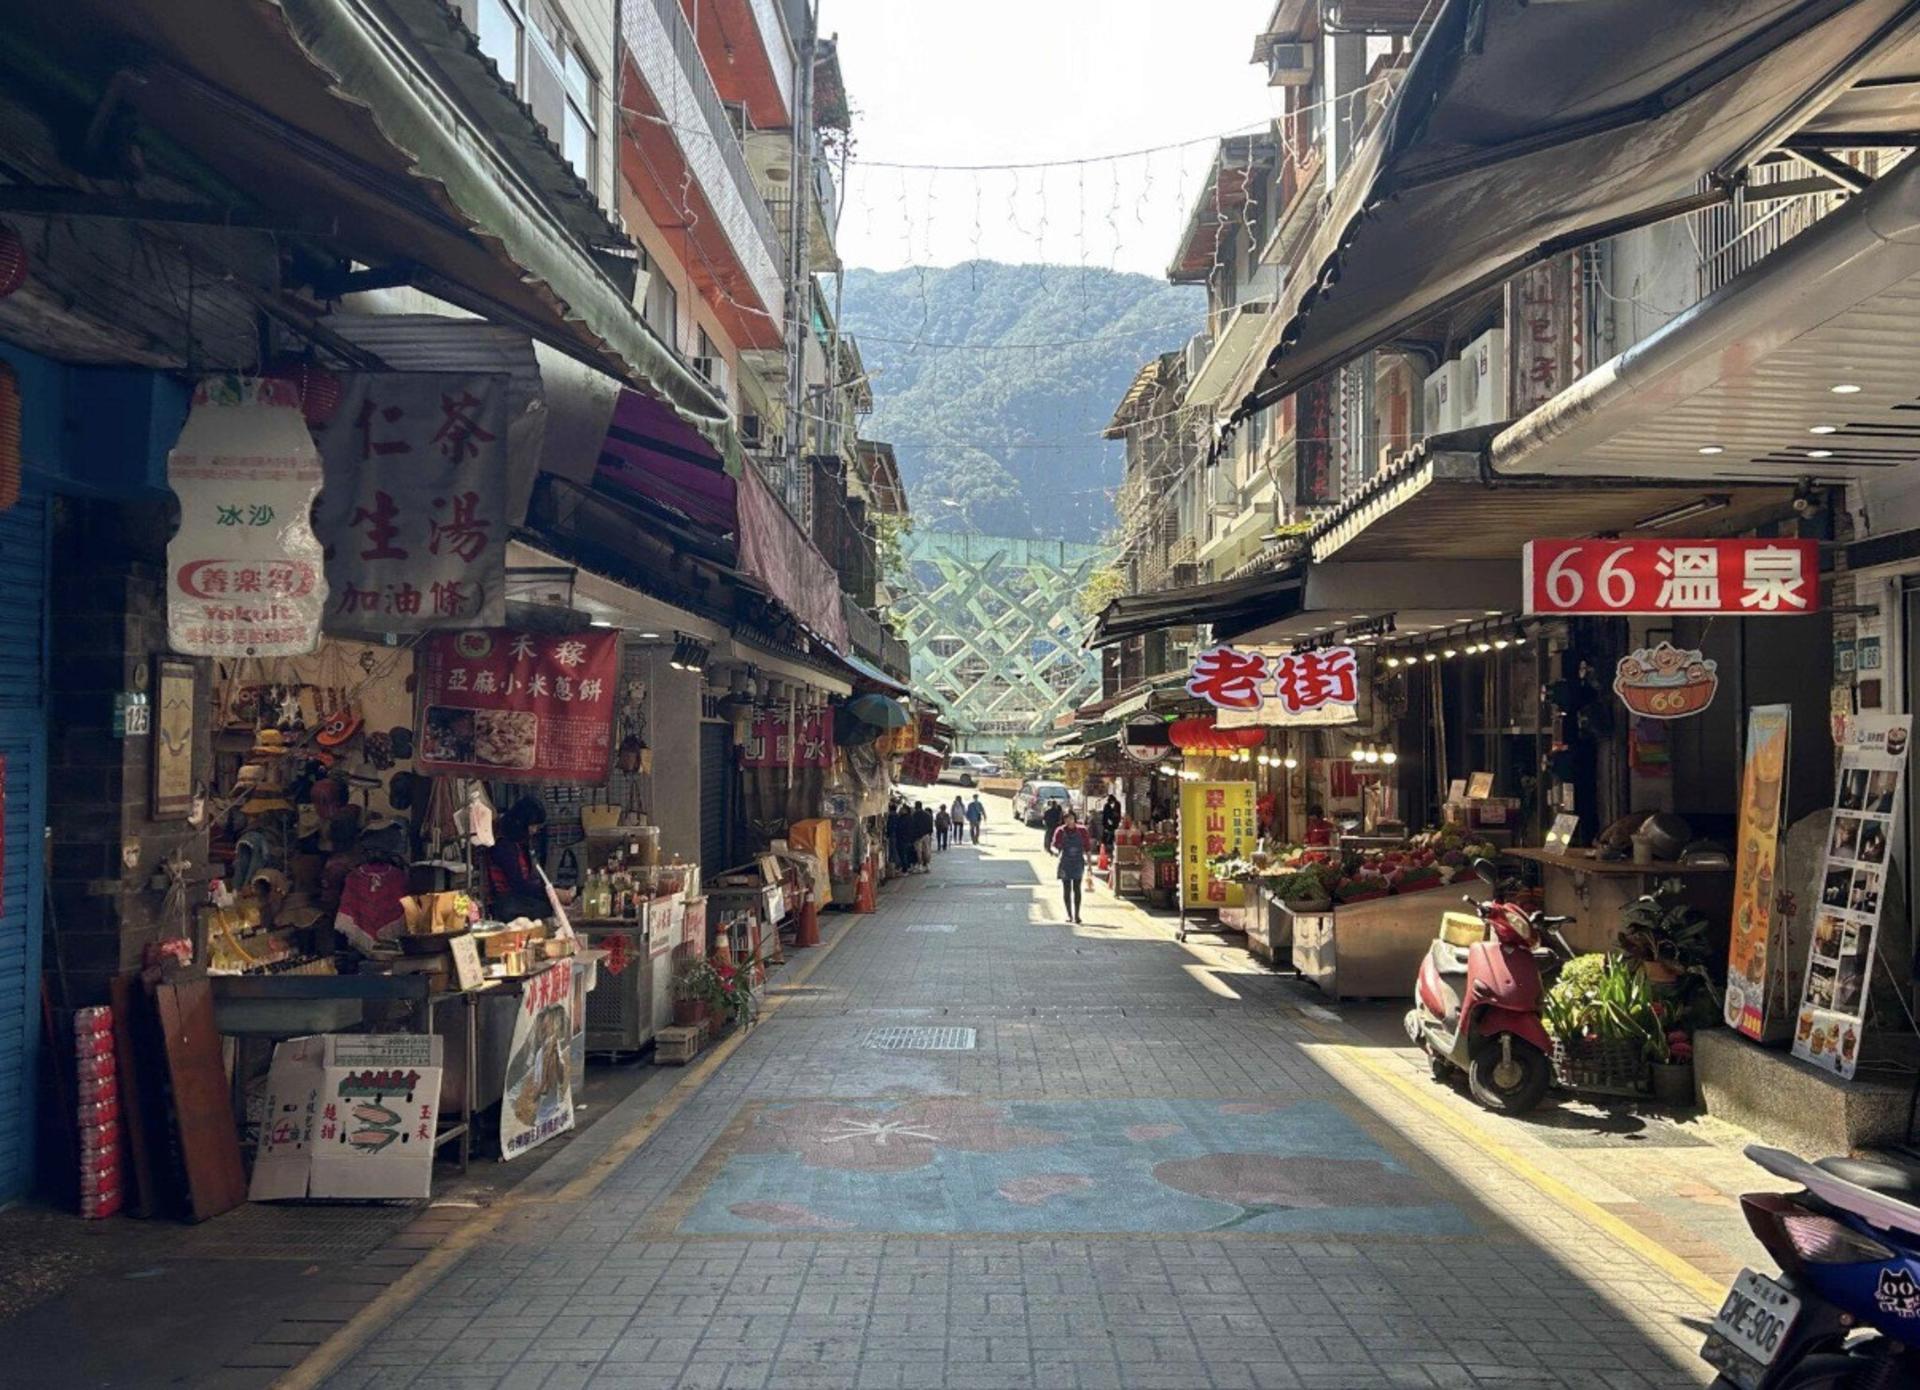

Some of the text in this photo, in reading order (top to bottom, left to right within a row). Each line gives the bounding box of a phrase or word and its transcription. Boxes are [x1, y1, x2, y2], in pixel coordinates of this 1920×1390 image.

[216, 504, 274, 527] 冰沙
[1545, 545, 1808, 610] 66溫泉
[509, 634, 588, 667] 禾稼
[1190, 648, 1357, 712] 老街
[1651, 693, 1686, 712] 66
[126, 706, 149, 733] 125
